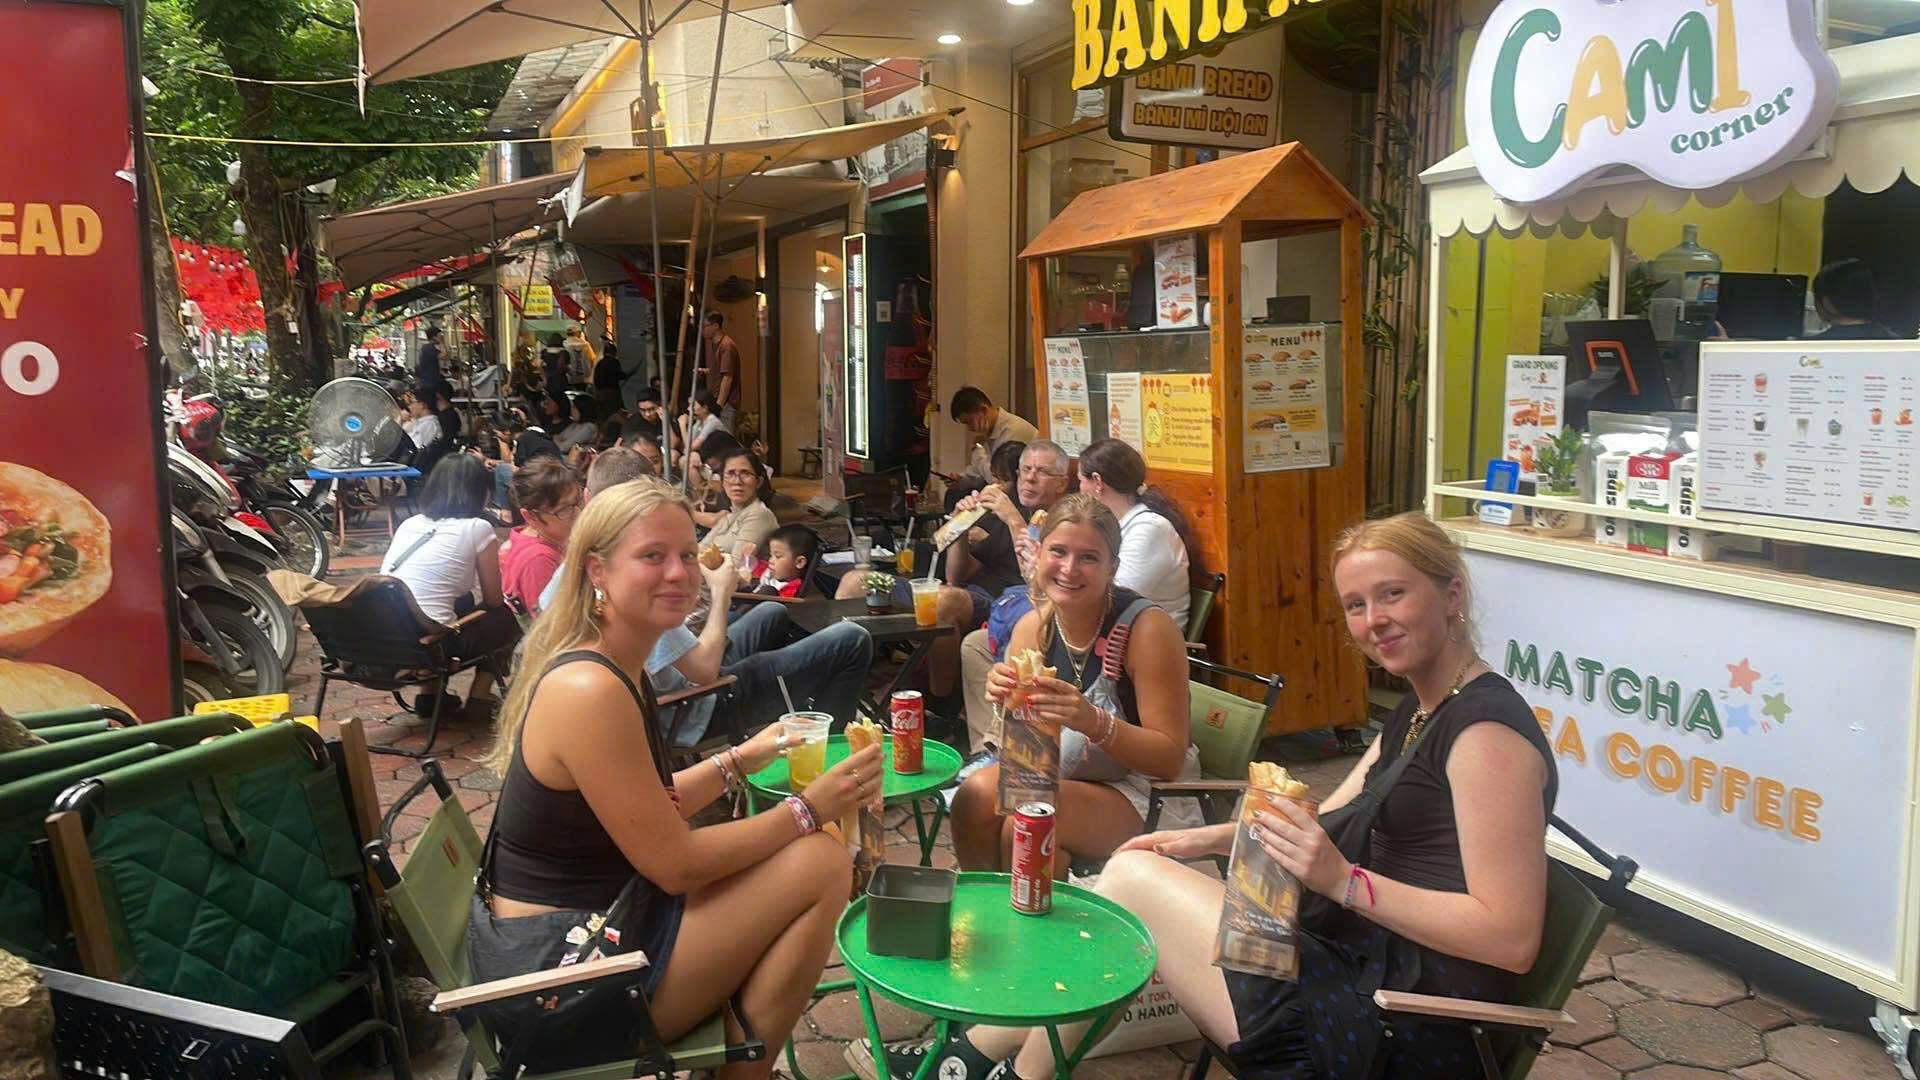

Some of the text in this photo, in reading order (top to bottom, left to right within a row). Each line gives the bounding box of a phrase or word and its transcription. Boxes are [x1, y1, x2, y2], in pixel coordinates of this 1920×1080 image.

[1203, 66, 1273, 102] BREAD
[1133, 101, 1181, 128] BÁNH
[1242, 114, 1268, 136] AN
[1671, 86, 1794, 154] corner
[1271, 336, 1300, 347] MENU
[1605, 469, 1618, 537] OSIDE
[1680, 476, 1693, 548] OSIDE
[1504, 639, 1724, 740] MATCHA
[1606, 732, 1824, 842] COFFEE
[1138, 1002, 1178, 1021] HANOI
